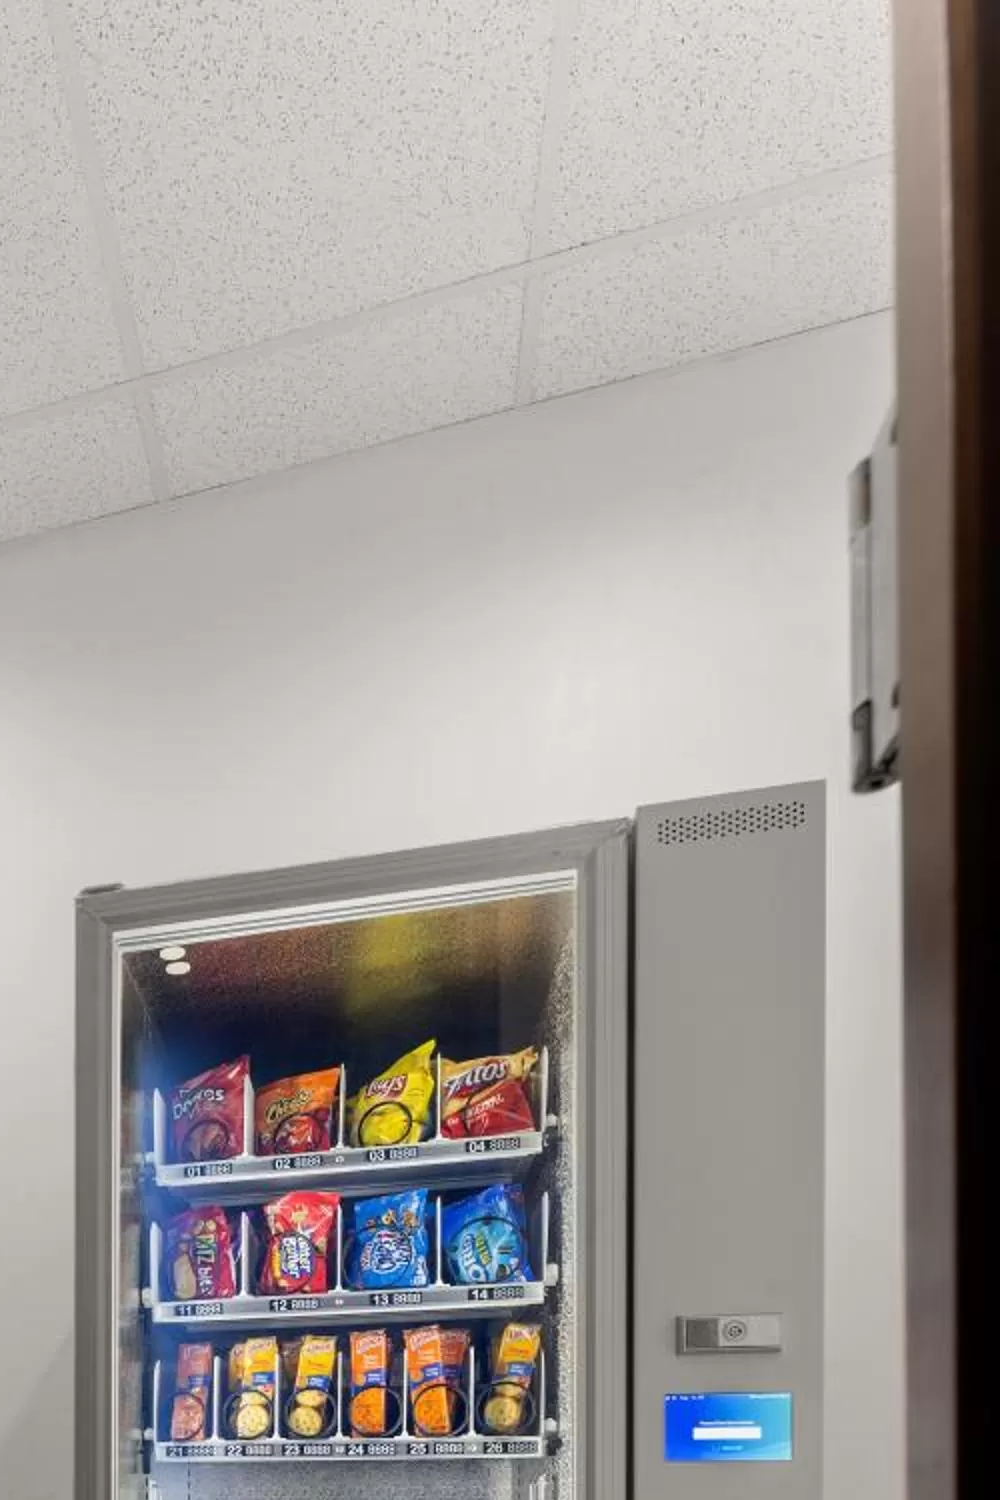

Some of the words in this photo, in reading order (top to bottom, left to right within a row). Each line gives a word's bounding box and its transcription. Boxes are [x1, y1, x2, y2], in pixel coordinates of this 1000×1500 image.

[469, 1141, 485, 1153] 04
[369, 1150, 386, 1161] 03
[275, 1158, 290, 1169] 02
[373, 1295, 389, 1305] 13
[471, 1289, 488, 1300] 14
[271, 1300, 288, 1311] 12
[227, 1446, 243, 1455] 22
[347, 1445, 363, 1454] 24
